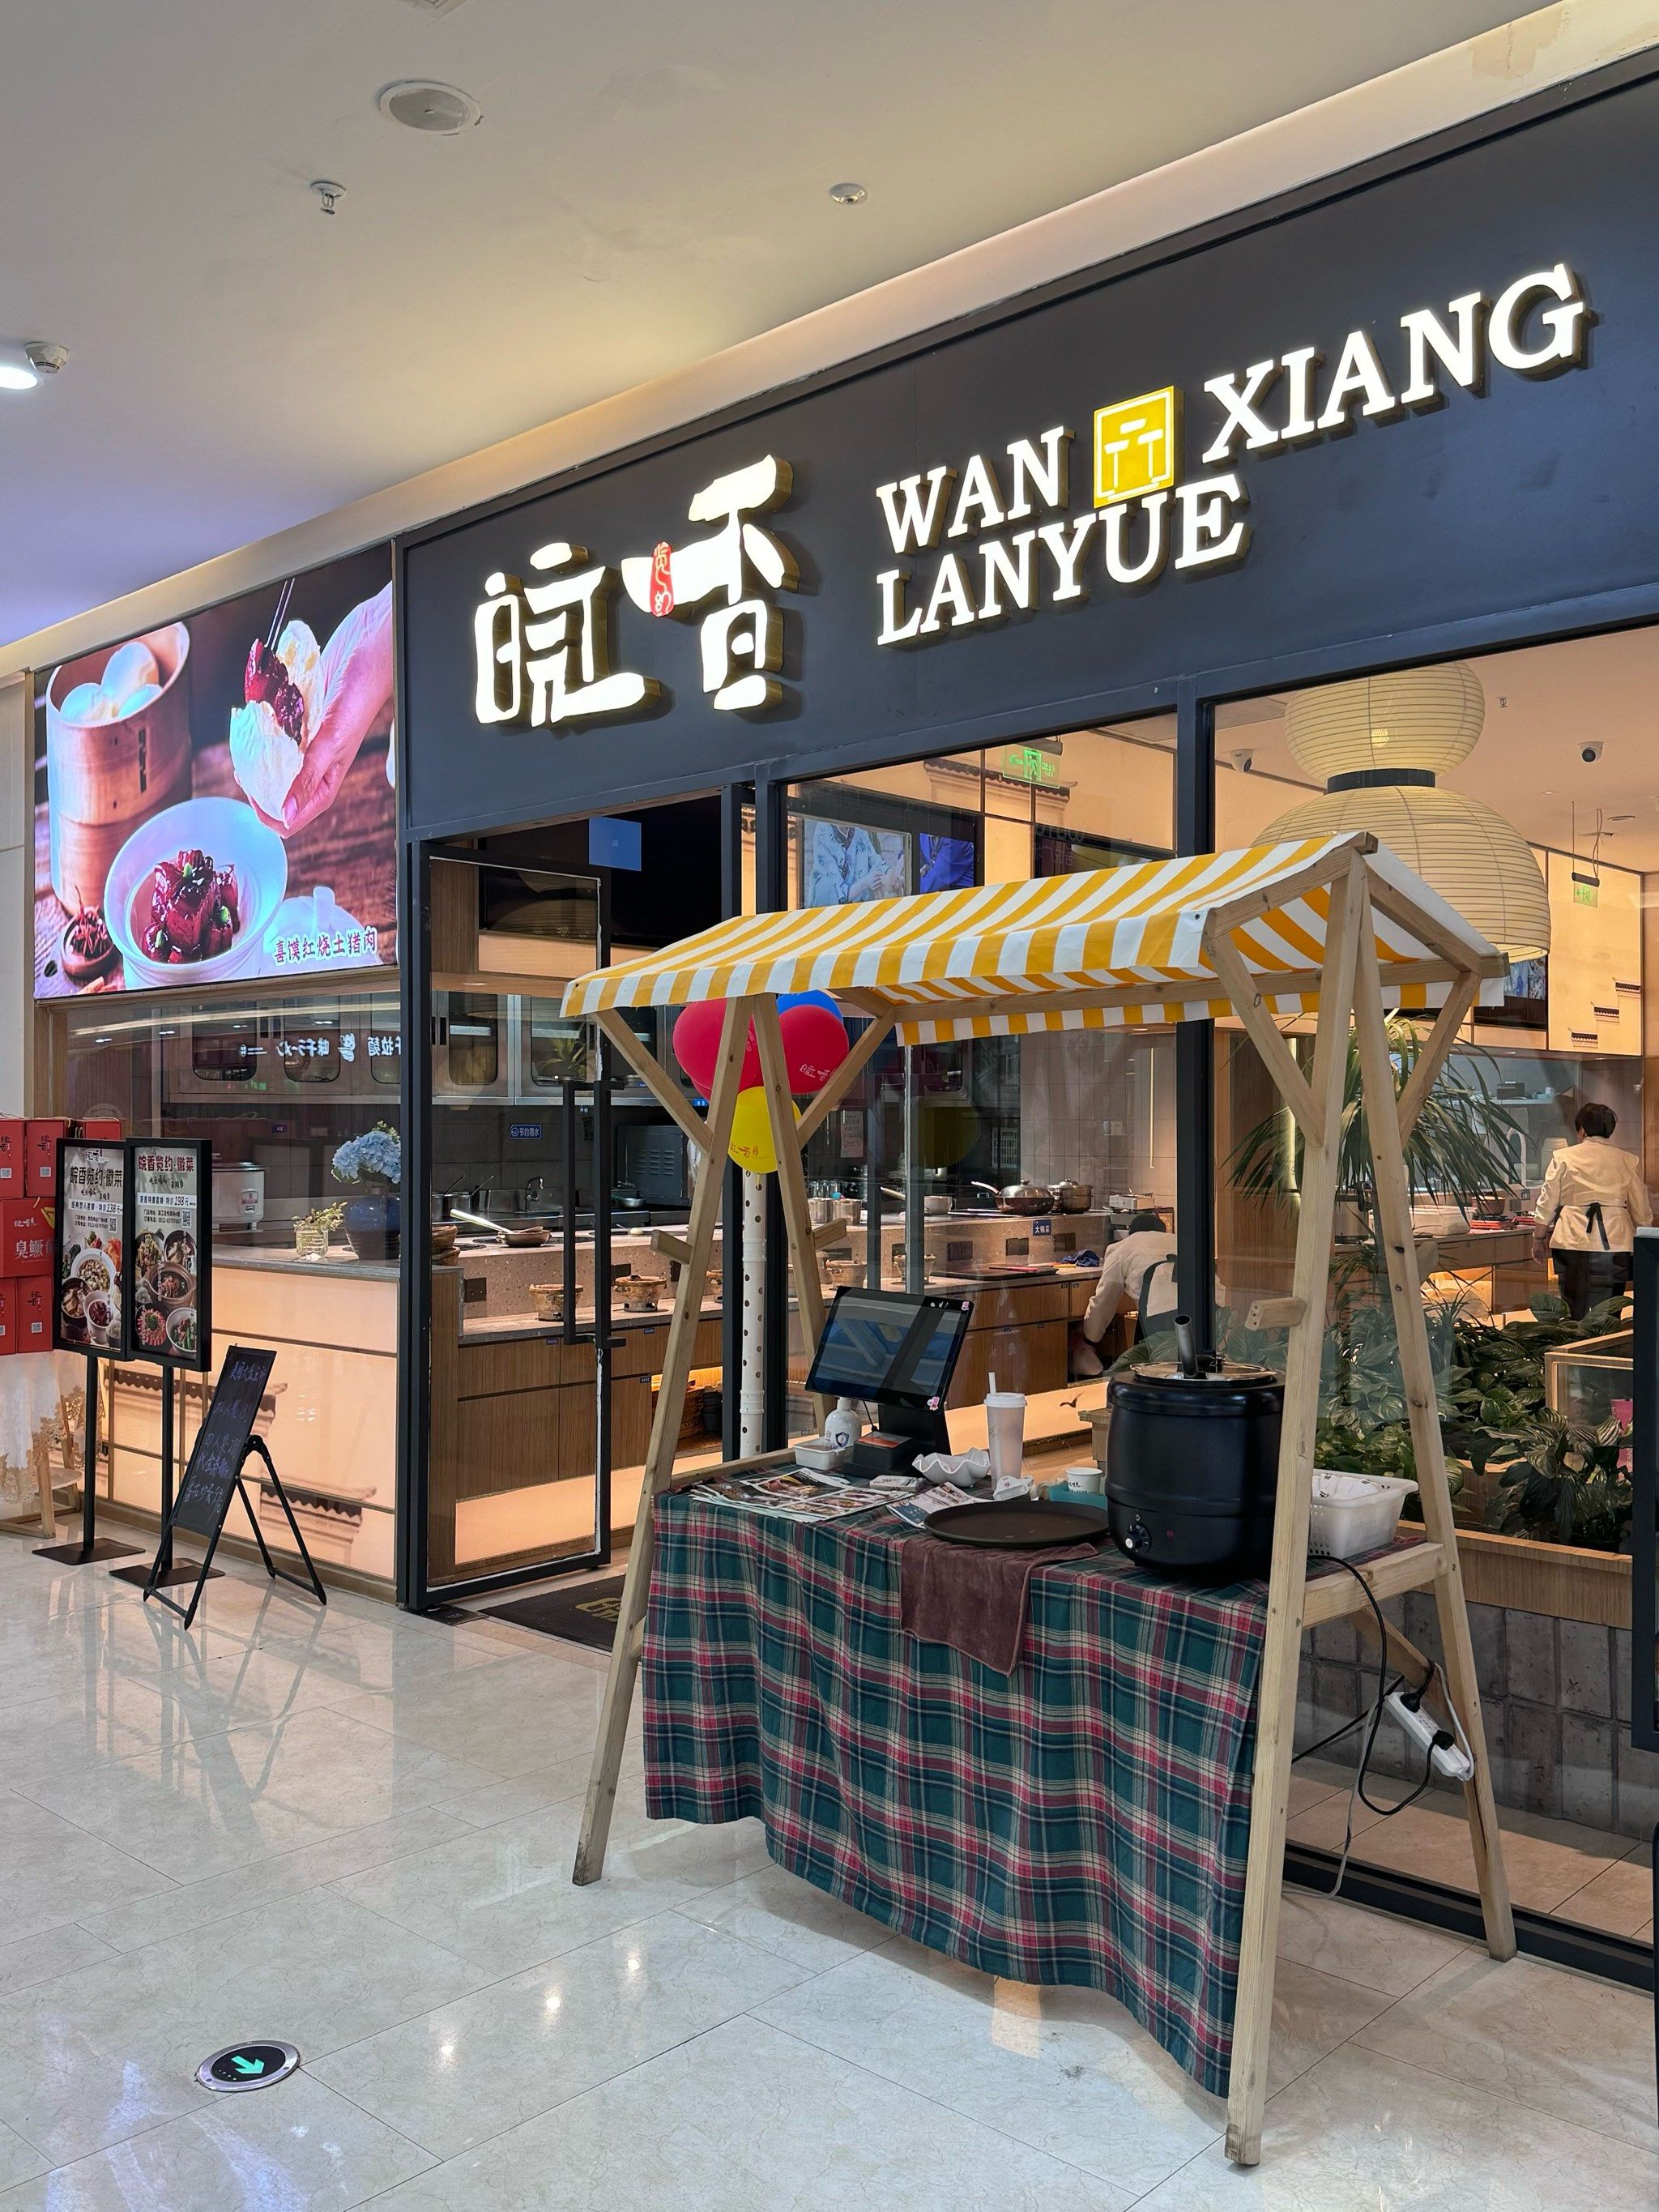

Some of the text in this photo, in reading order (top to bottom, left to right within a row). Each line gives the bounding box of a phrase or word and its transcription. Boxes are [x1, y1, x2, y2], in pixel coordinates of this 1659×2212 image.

[876, 262, 1588, 556] WAN XIANG
[474, 455, 795, 728] 皖香
[876, 473, 1248, 647] LANYUE
[274, 929, 377, 964] 喜馍红烧土猪肉
[518, 1127, 539, 1137] 节约用水
